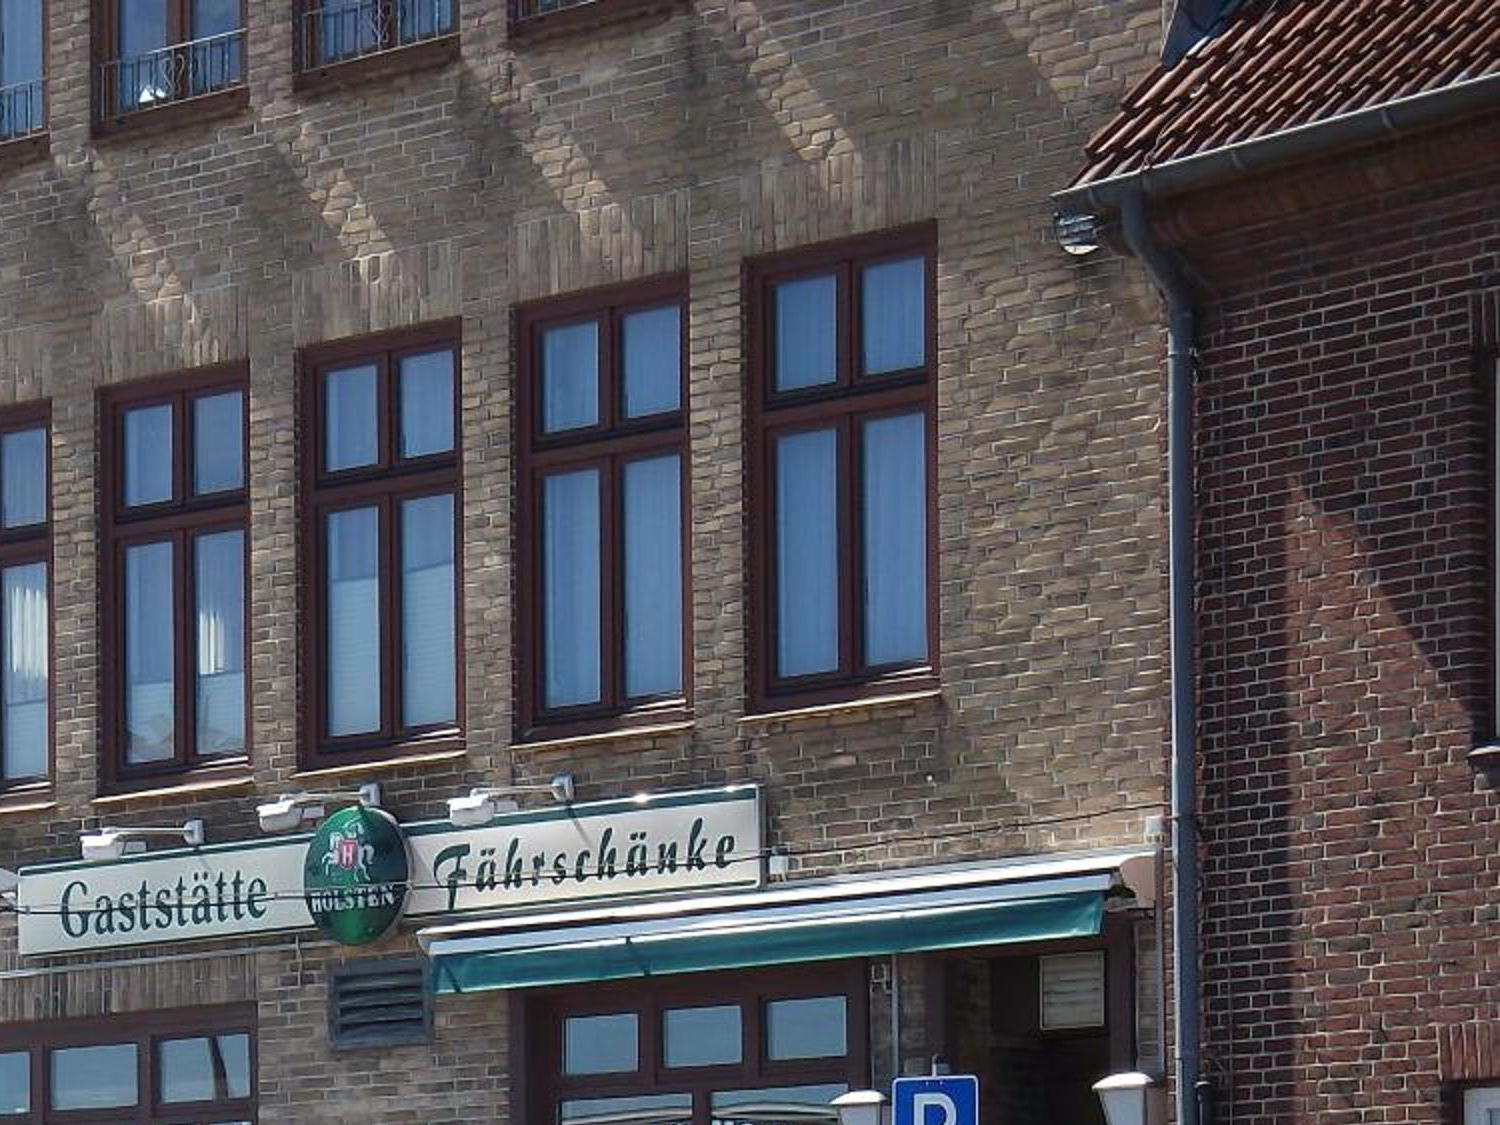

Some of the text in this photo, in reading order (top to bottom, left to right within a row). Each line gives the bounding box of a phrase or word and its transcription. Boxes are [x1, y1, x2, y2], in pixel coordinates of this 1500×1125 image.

[433, 817, 735, 910] Fährschänke
[61, 870, 267, 938] Gaststätte
[310, 885, 395, 913] HOLSTEN
